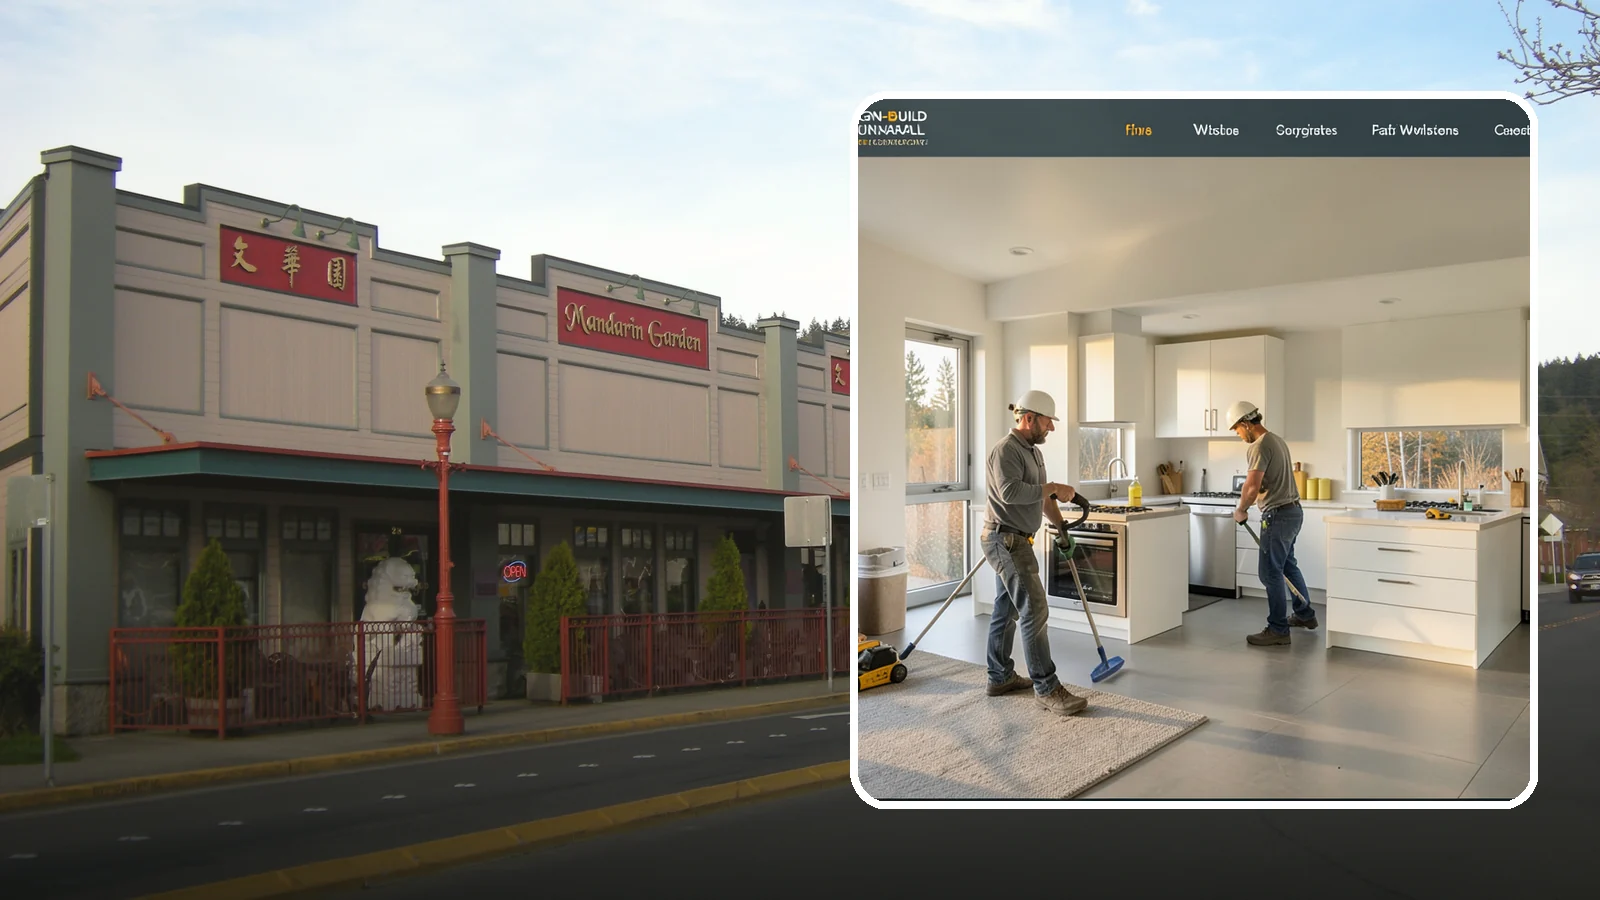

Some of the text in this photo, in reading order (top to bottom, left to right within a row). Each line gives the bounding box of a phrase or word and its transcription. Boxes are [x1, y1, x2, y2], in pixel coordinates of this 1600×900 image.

[230, 235, 347, 292] 文華園
[564, 302, 702, 353] Mandarin Garden
[503, 565, 527, 579] OPEN
